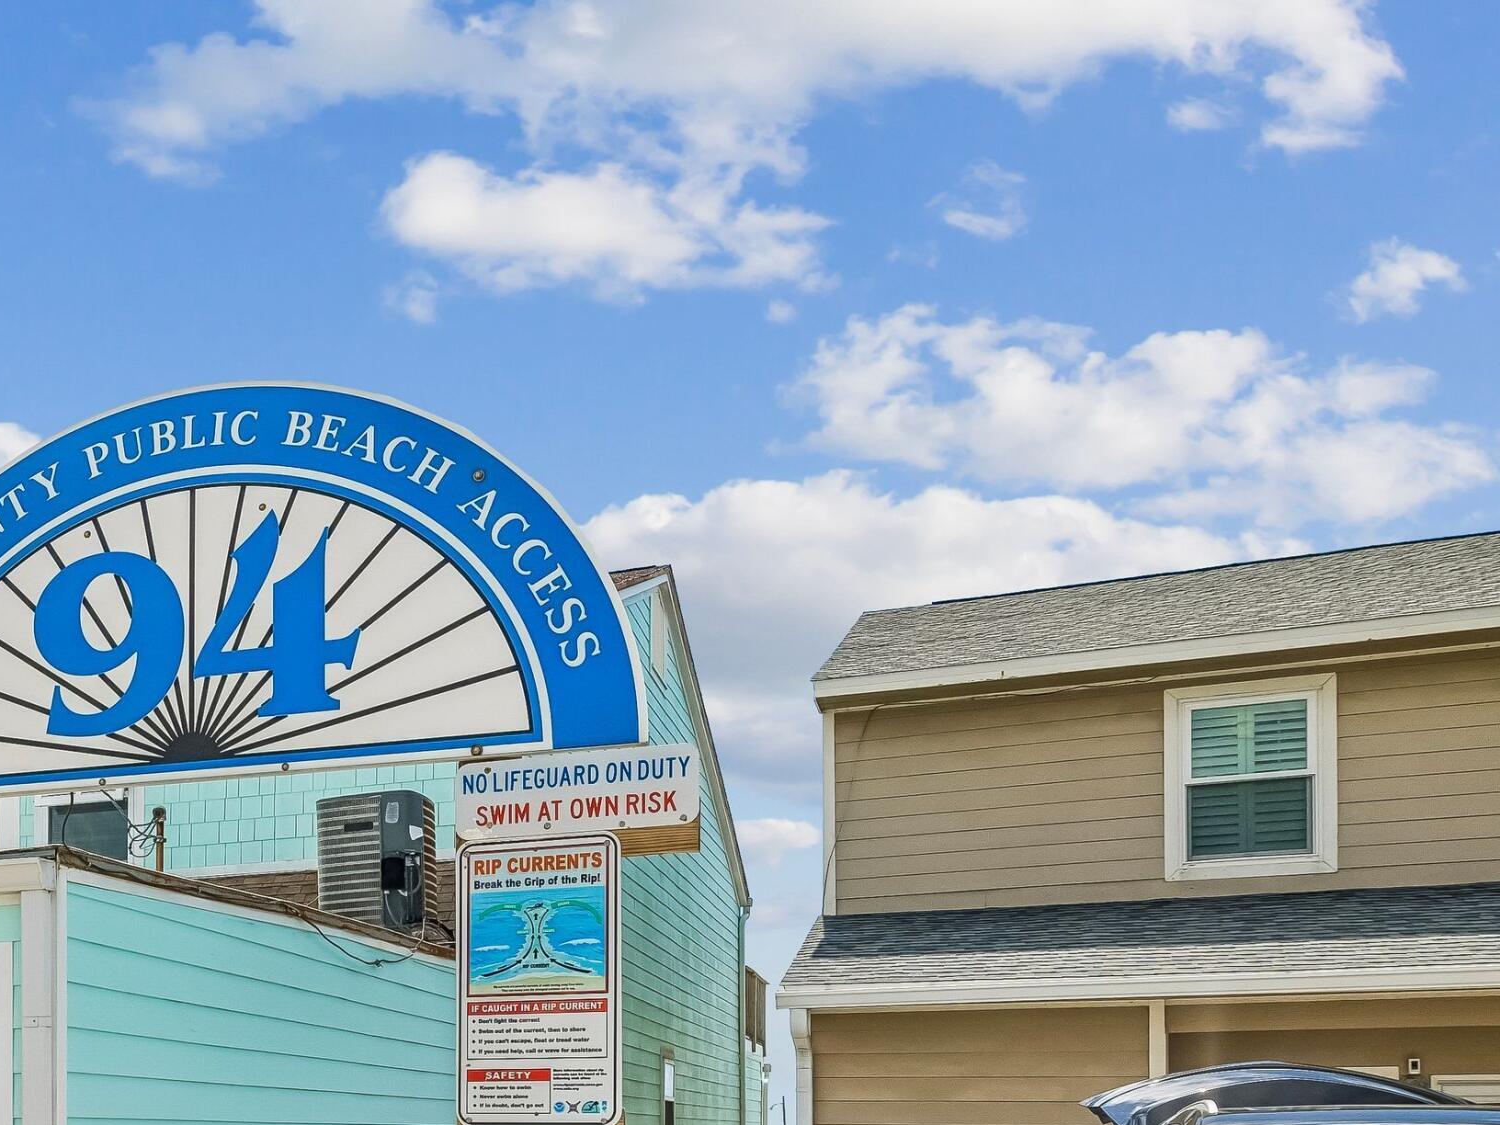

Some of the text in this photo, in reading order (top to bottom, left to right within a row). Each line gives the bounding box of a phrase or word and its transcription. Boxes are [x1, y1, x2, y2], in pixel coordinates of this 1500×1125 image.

[87, 411, 260, 478] PUBLIC
[285, 411, 456, 495] BEACH
[457, 487, 602, 668] ACCESS
[34, 509, 360, 736] 94
[462, 756, 690, 794] NO LIFEGUARD ON DUTY
[476, 791, 677, 826] SWIM AT OWN RISK
[474, 853, 603, 875] RIP CURRENTS
[474, 874, 600, 889] Break the Grip of the Rip!
[481, 1004, 518, 1012] CAUGHT
[558, 1002, 603, 1010] CURRENT
[484, 1071, 531, 1080] SAFETY
